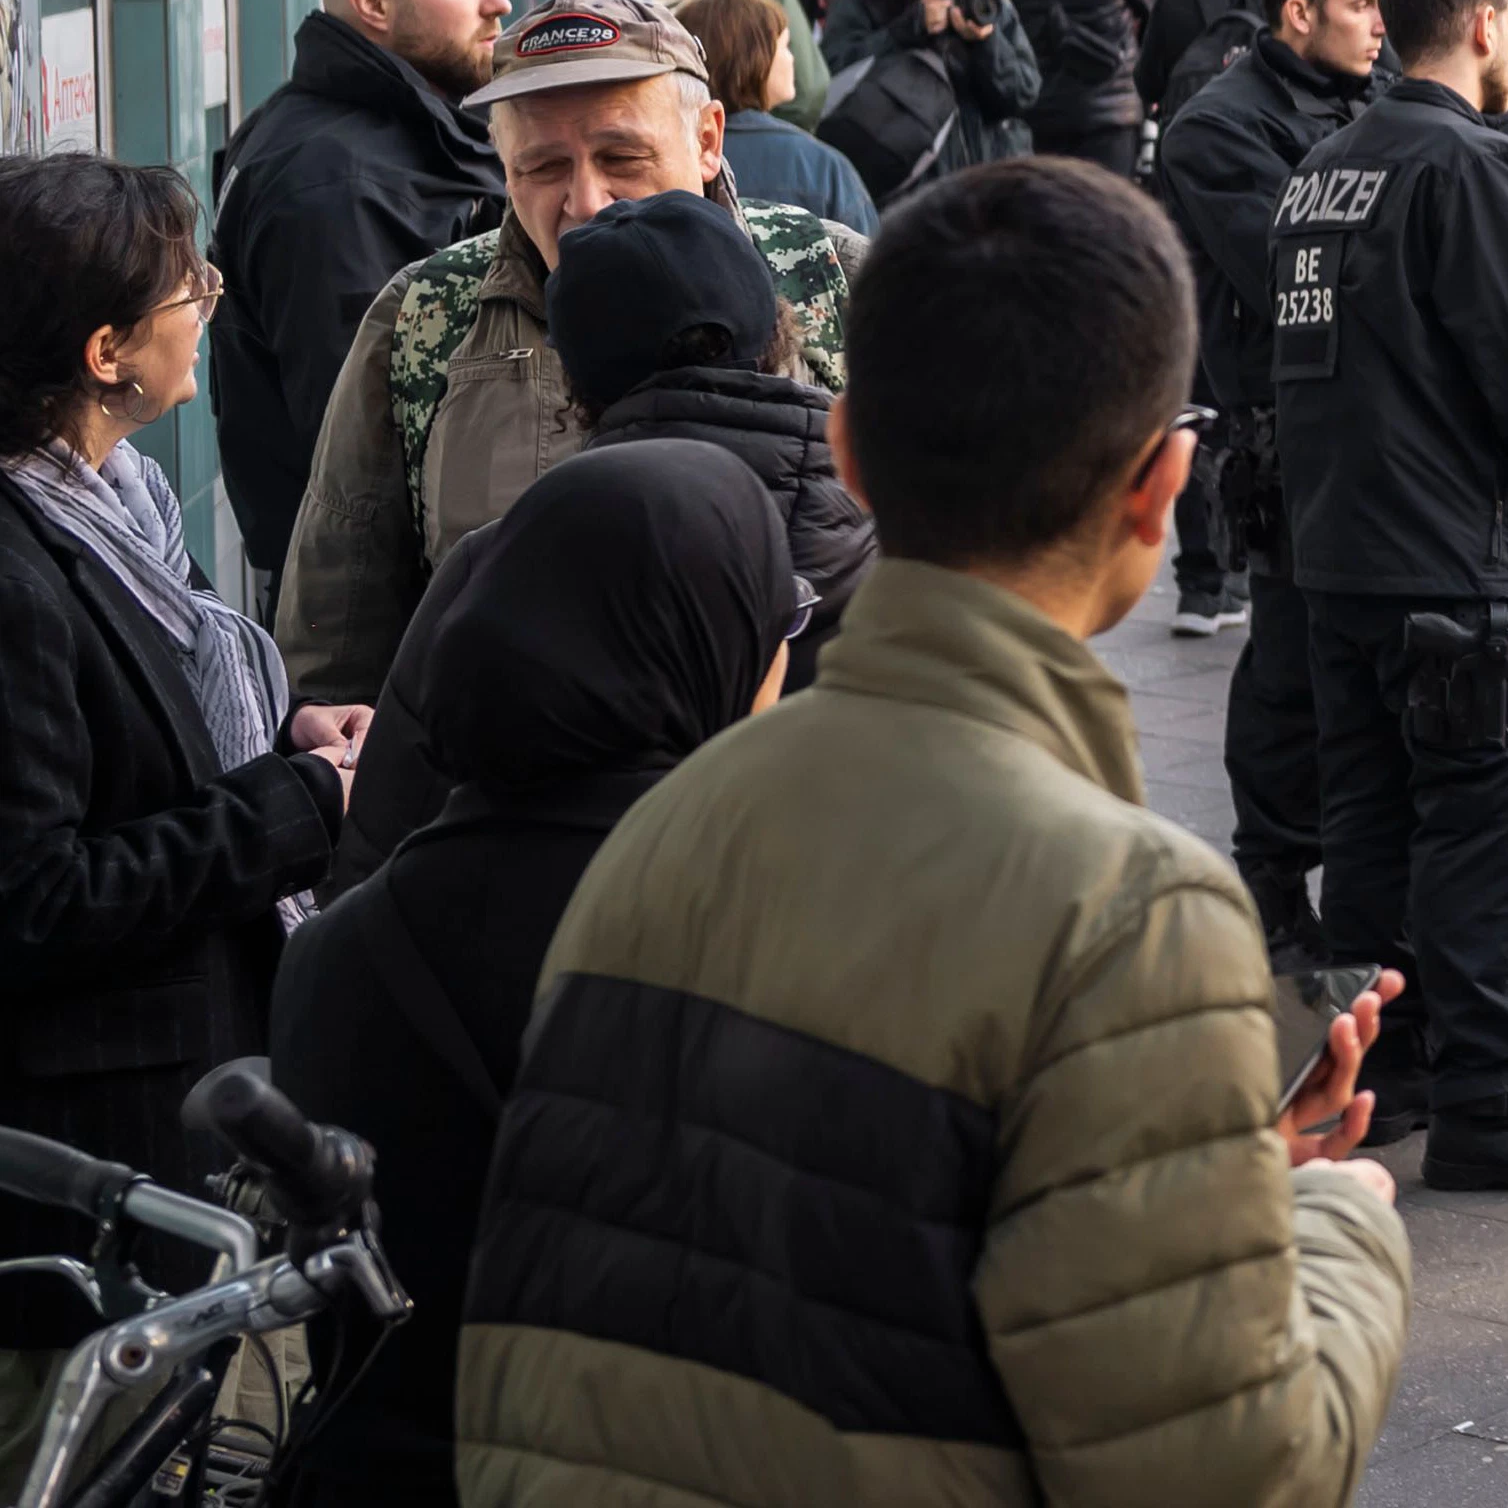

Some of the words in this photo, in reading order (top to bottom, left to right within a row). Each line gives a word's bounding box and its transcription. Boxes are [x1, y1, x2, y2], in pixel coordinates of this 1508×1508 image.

[521, 28, 589, 52] FRANCE
[590, 28, 614, 40] 98
[1274, 169, 1387, 227] POLIZEI
[1295, 247, 1322, 284] BE
[1277, 287, 1333, 326] 25238
